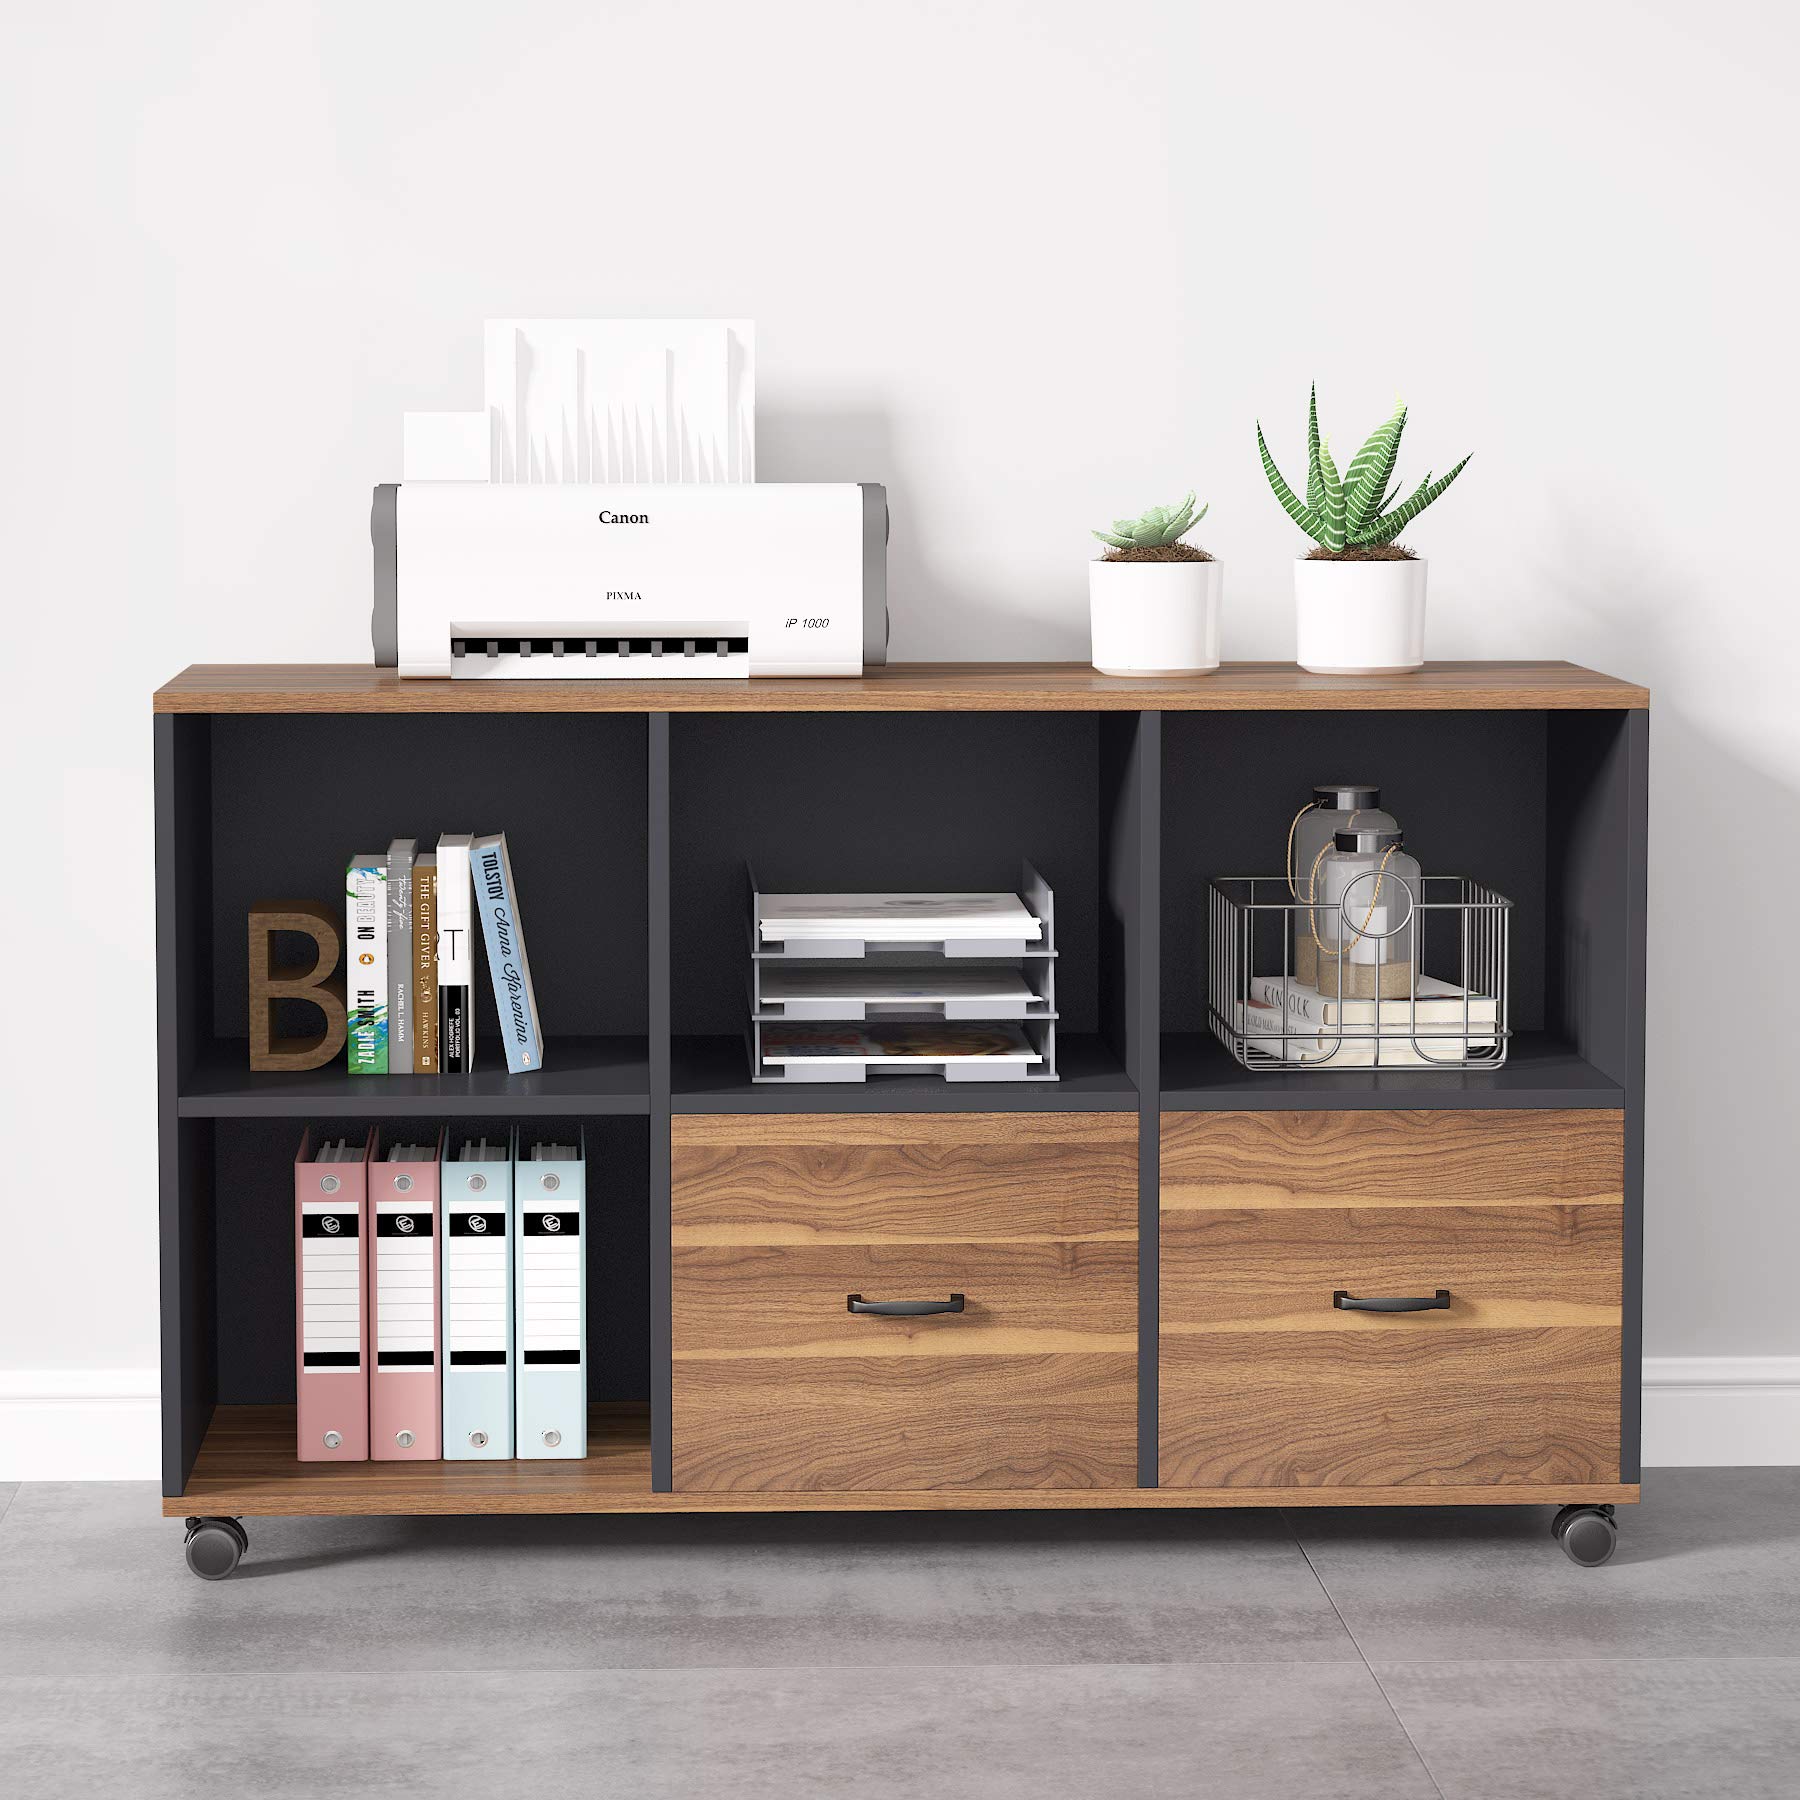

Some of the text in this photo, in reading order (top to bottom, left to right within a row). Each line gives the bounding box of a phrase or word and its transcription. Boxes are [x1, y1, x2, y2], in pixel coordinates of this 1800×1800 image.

[598, 510, 650, 525] Canon
[606, 590, 642, 600] PIXMA
[785, 617, 830, 629] iP 1000
[357, 878, 376, 940] ON BEAUTY
[420, 875, 430, 969] THE GIFT GIVER
[481, 851, 528, 1046] TOLSTOY Anna Karenina
[248, 912, 348, 1072] B
[1264, 984, 1310, 1019] KINOLK
[357, 990, 376, 1065] ZADIE SMITH
